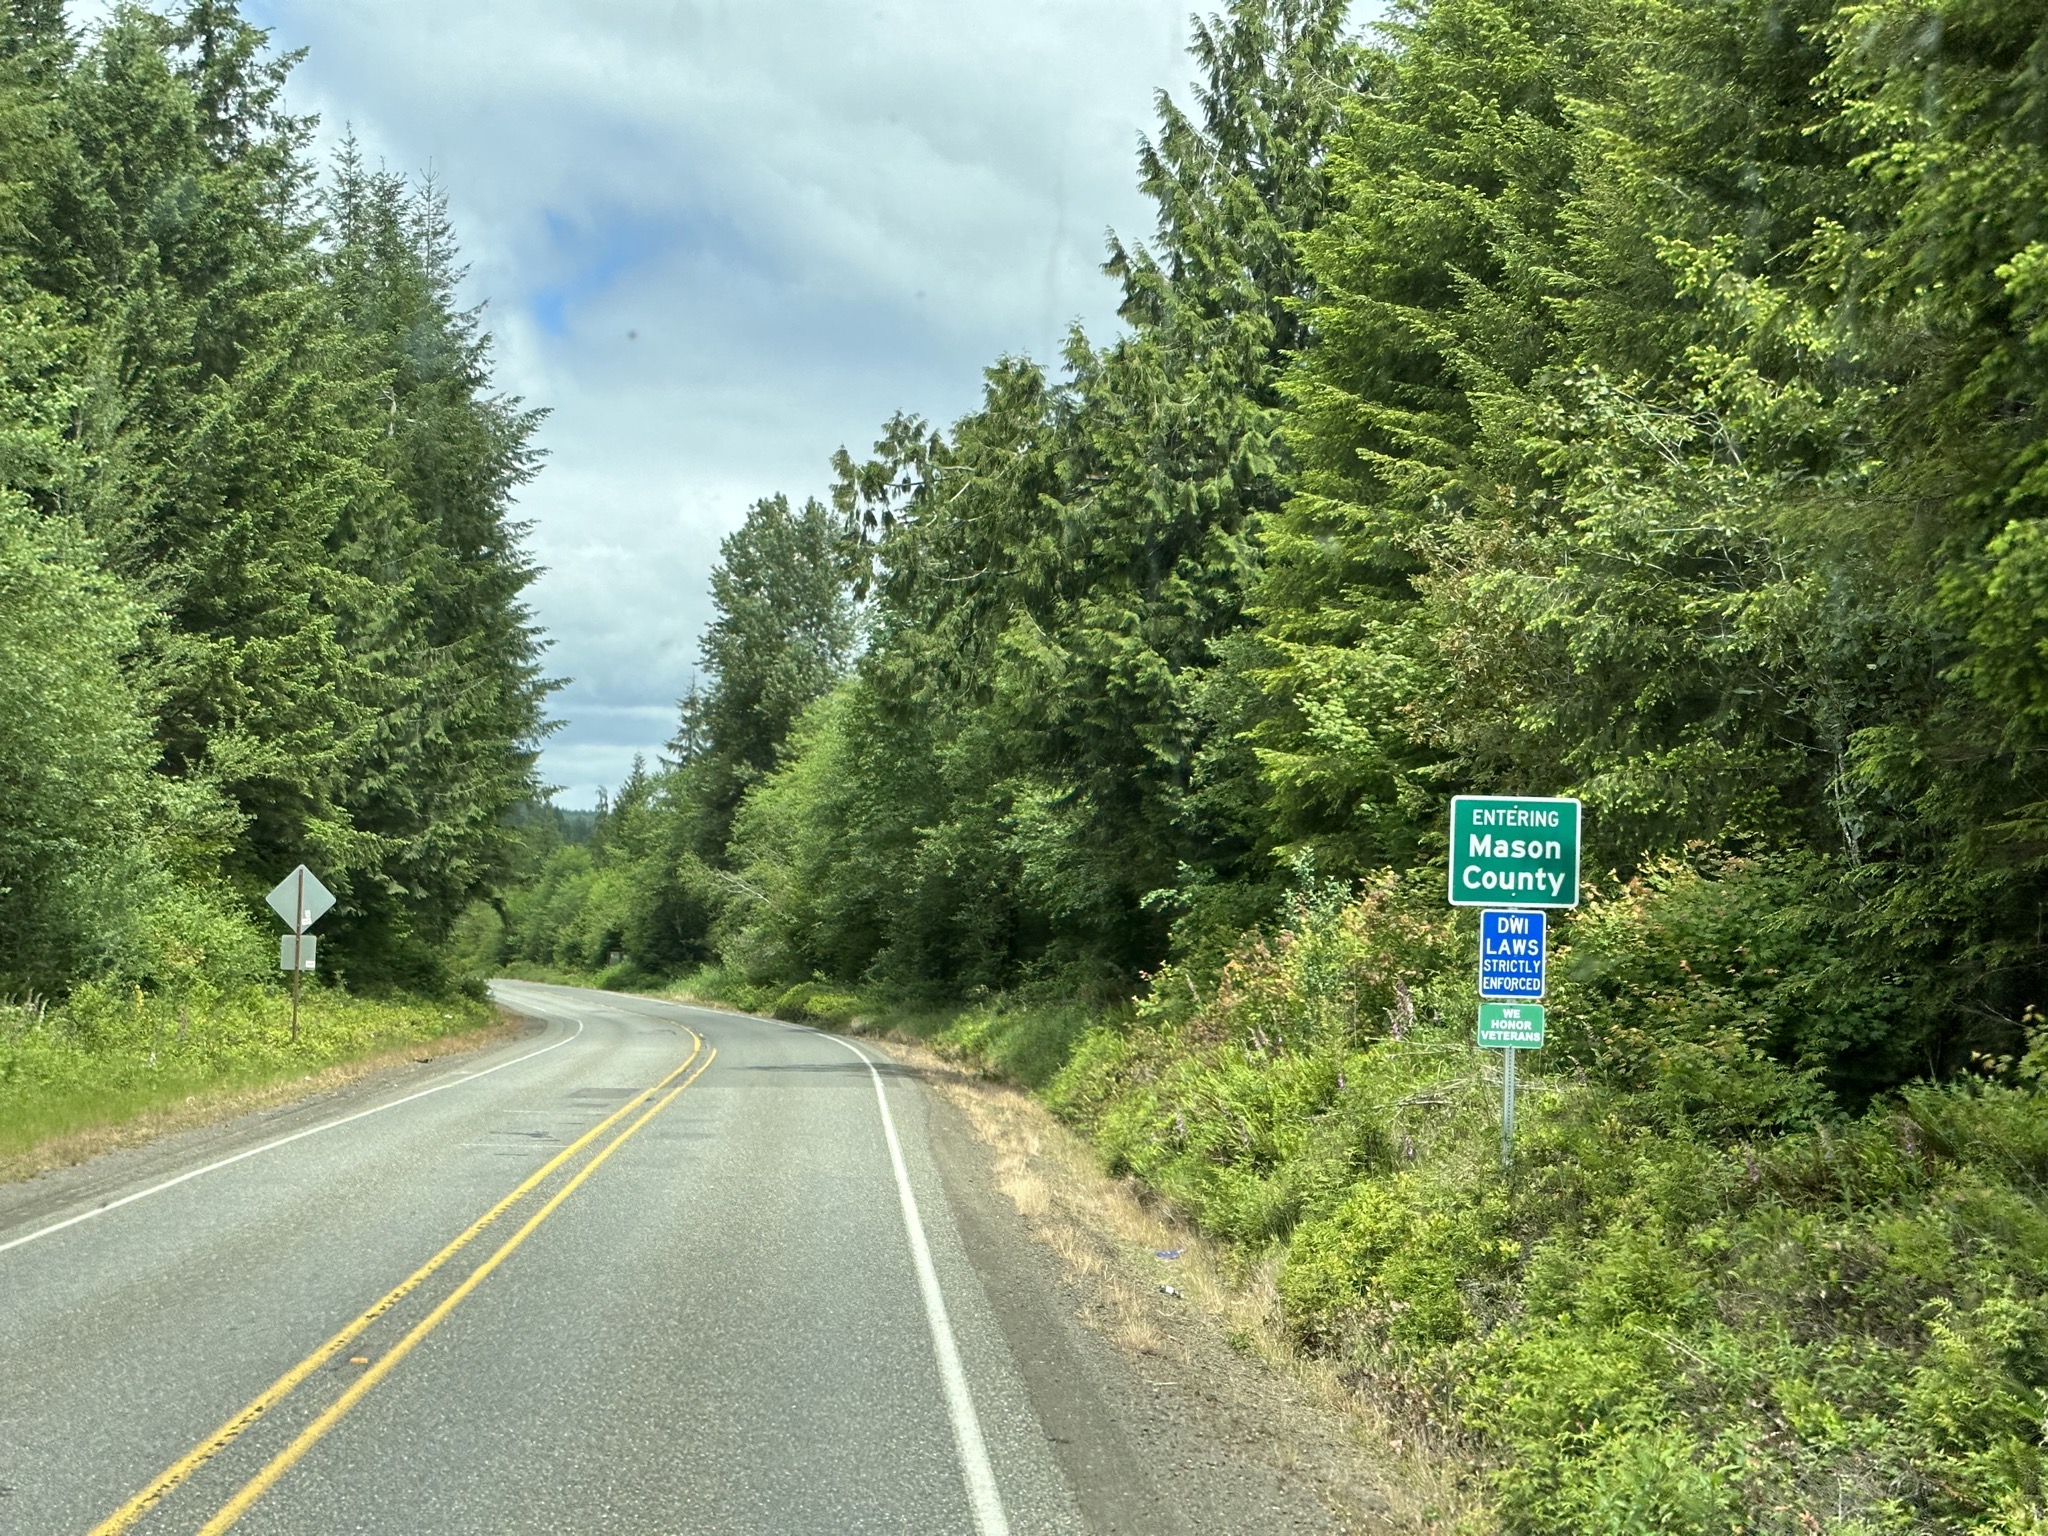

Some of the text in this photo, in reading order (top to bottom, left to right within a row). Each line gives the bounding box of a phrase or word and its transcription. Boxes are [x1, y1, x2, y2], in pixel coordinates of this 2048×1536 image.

[1473, 809, 1559, 827] ENTERING
[1469, 834, 1561, 859] Mason
[1463, 865, 1565, 896] County
[1498, 917, 1528, 934] DWI
[1486, 938, 1539, 955] LAWS
[1483, 959, 1540, 973] STRICTLY
[1483, 977, 1540, 991] ENFORCED
[1503, 1008, 1521, 1019] WE
[1491, 1020, 1532, 1030] HONOR
[1481, 1030, 1540, 1042] VETERANS
